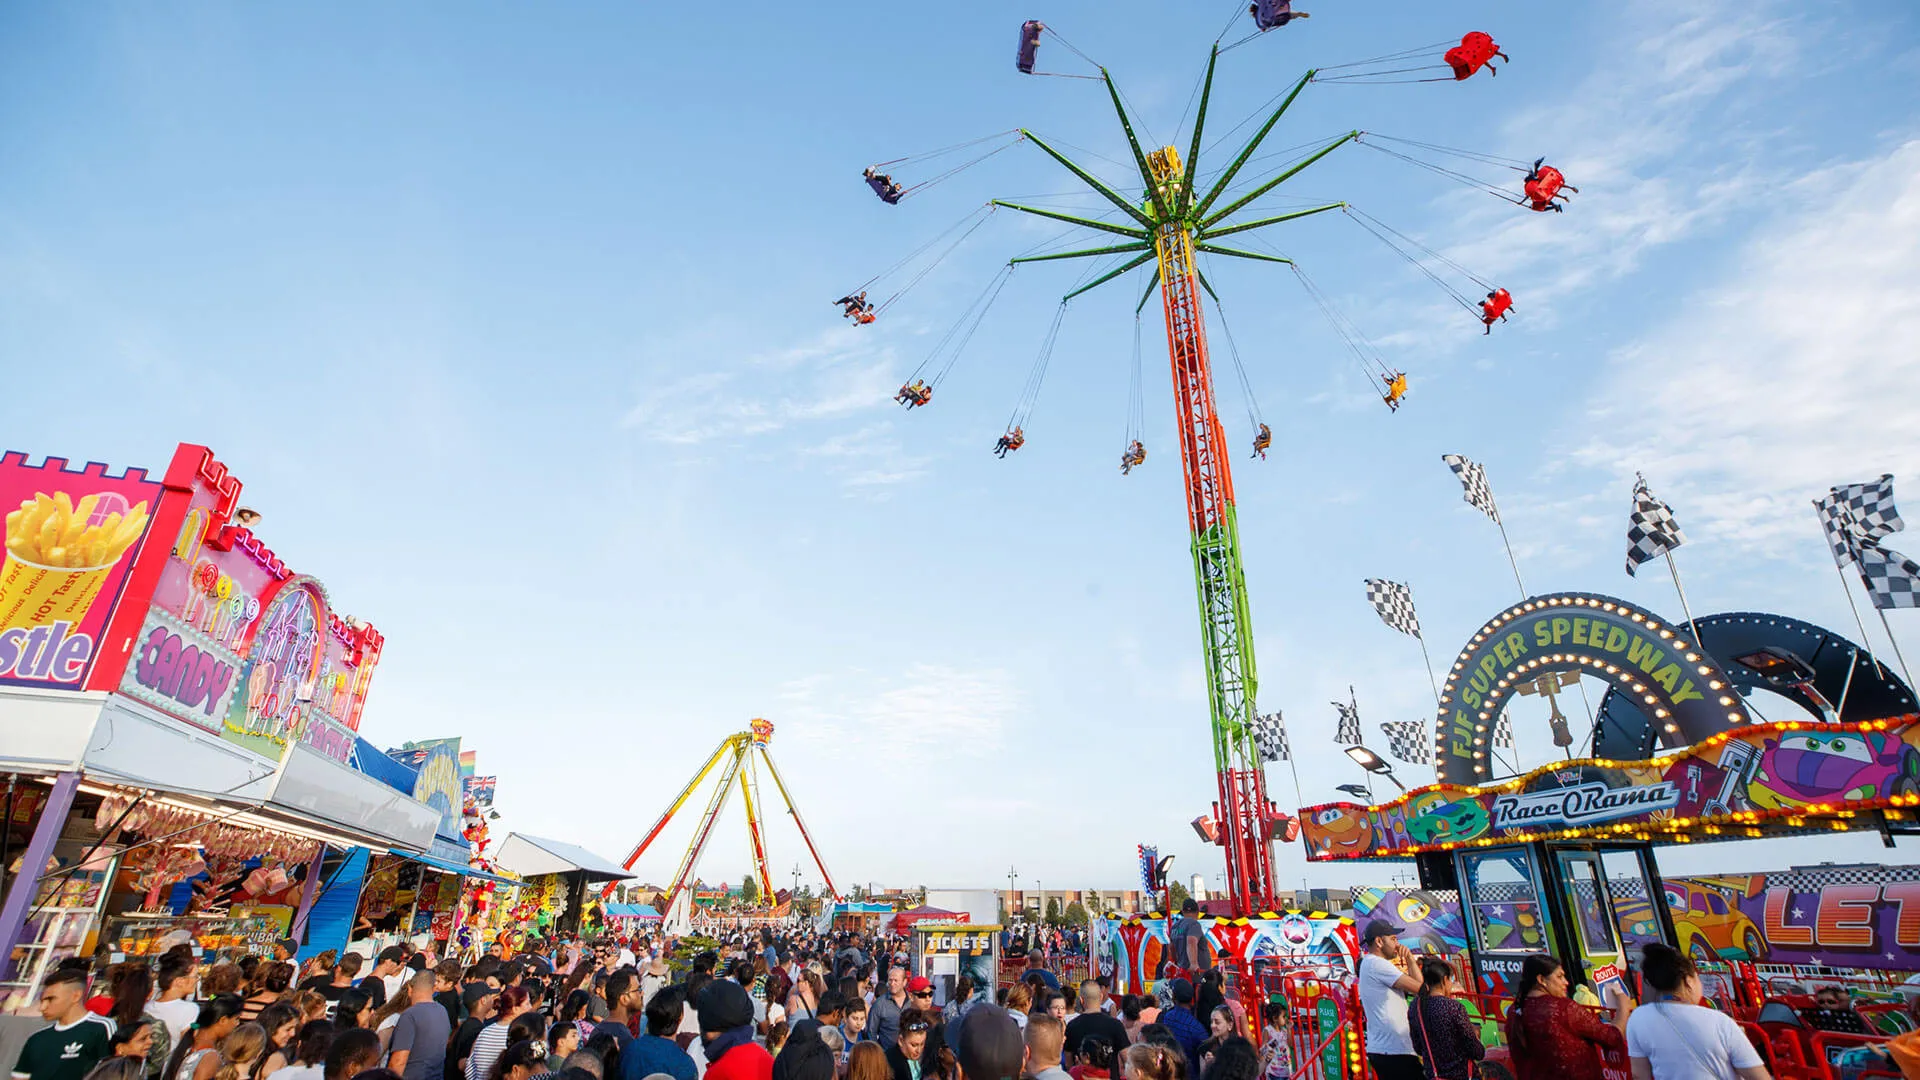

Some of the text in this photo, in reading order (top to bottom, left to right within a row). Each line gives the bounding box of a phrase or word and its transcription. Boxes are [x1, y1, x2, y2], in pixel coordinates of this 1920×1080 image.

[30, 598, 57, 623] HOT
[135, 626, 234, 716] CANDY
[1452, 617, 1704, 759] FJF SUPER SPEEDWAY
[927, 936, 989, 949] TICKETS
[1481, 960, 1506, 972] RACE
[1595, 966, 1618, 981] ROUTE
